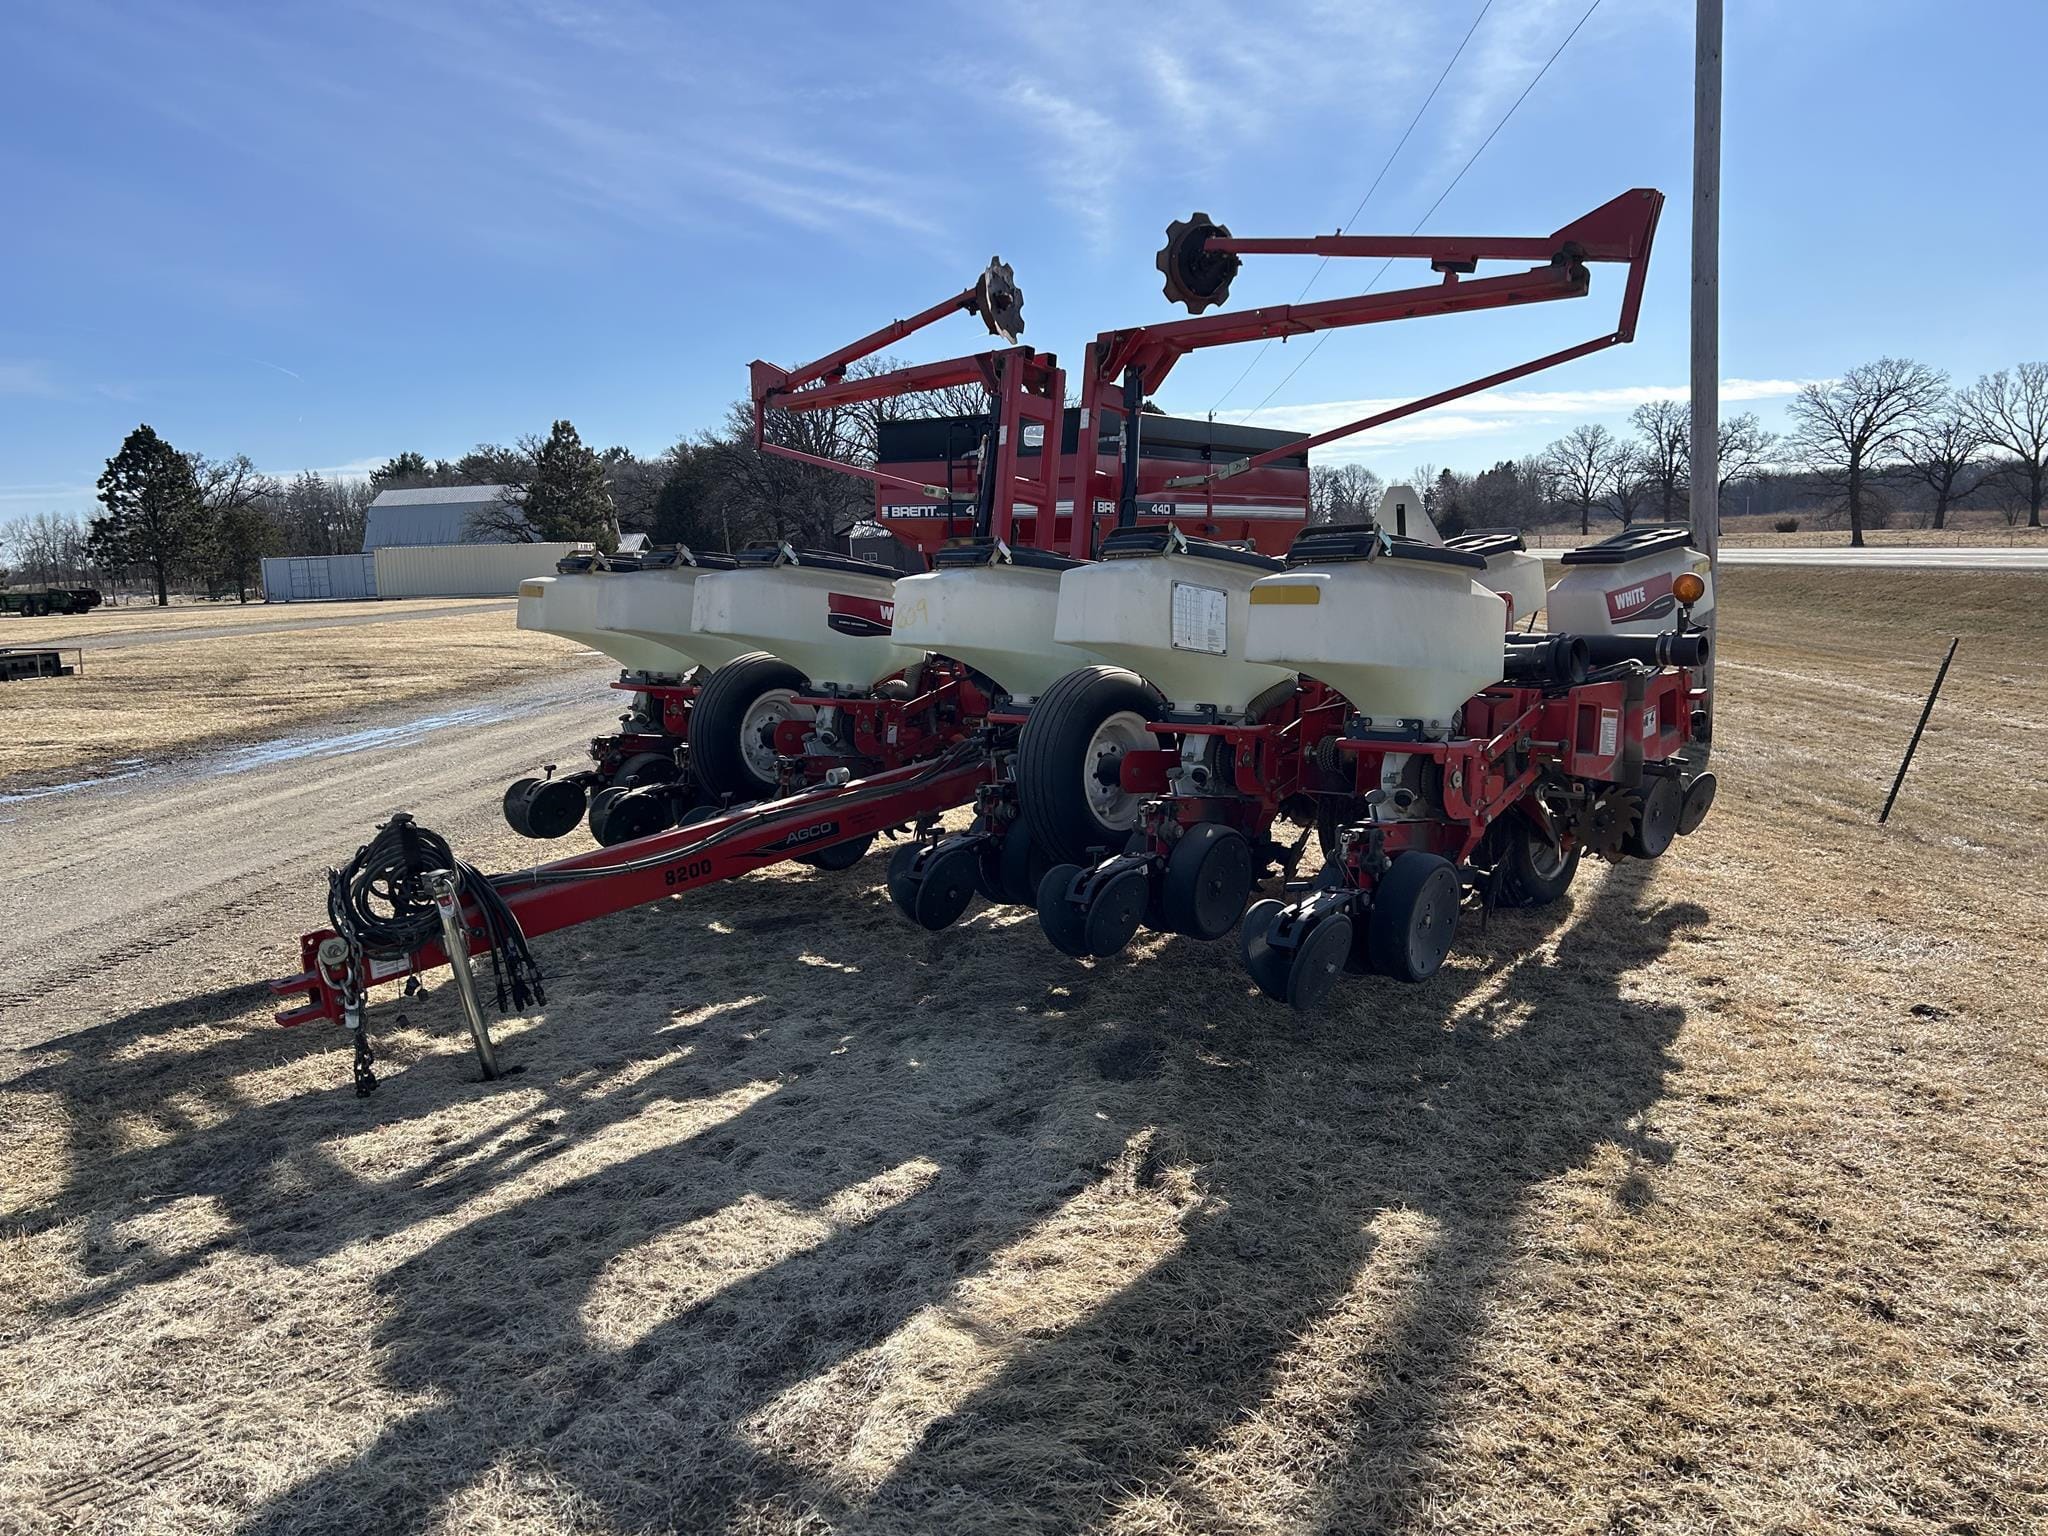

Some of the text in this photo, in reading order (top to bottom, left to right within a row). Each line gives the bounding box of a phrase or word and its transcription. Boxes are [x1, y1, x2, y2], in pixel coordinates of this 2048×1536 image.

[891, 505, 937, 517] BRENT
[1097, 501, 1171, 515] BRE 440
[1614, 586, 1646, 610] WHITE
[786, 822, 832, 845] AGCO
[665, 859, 712, 886] 8200
